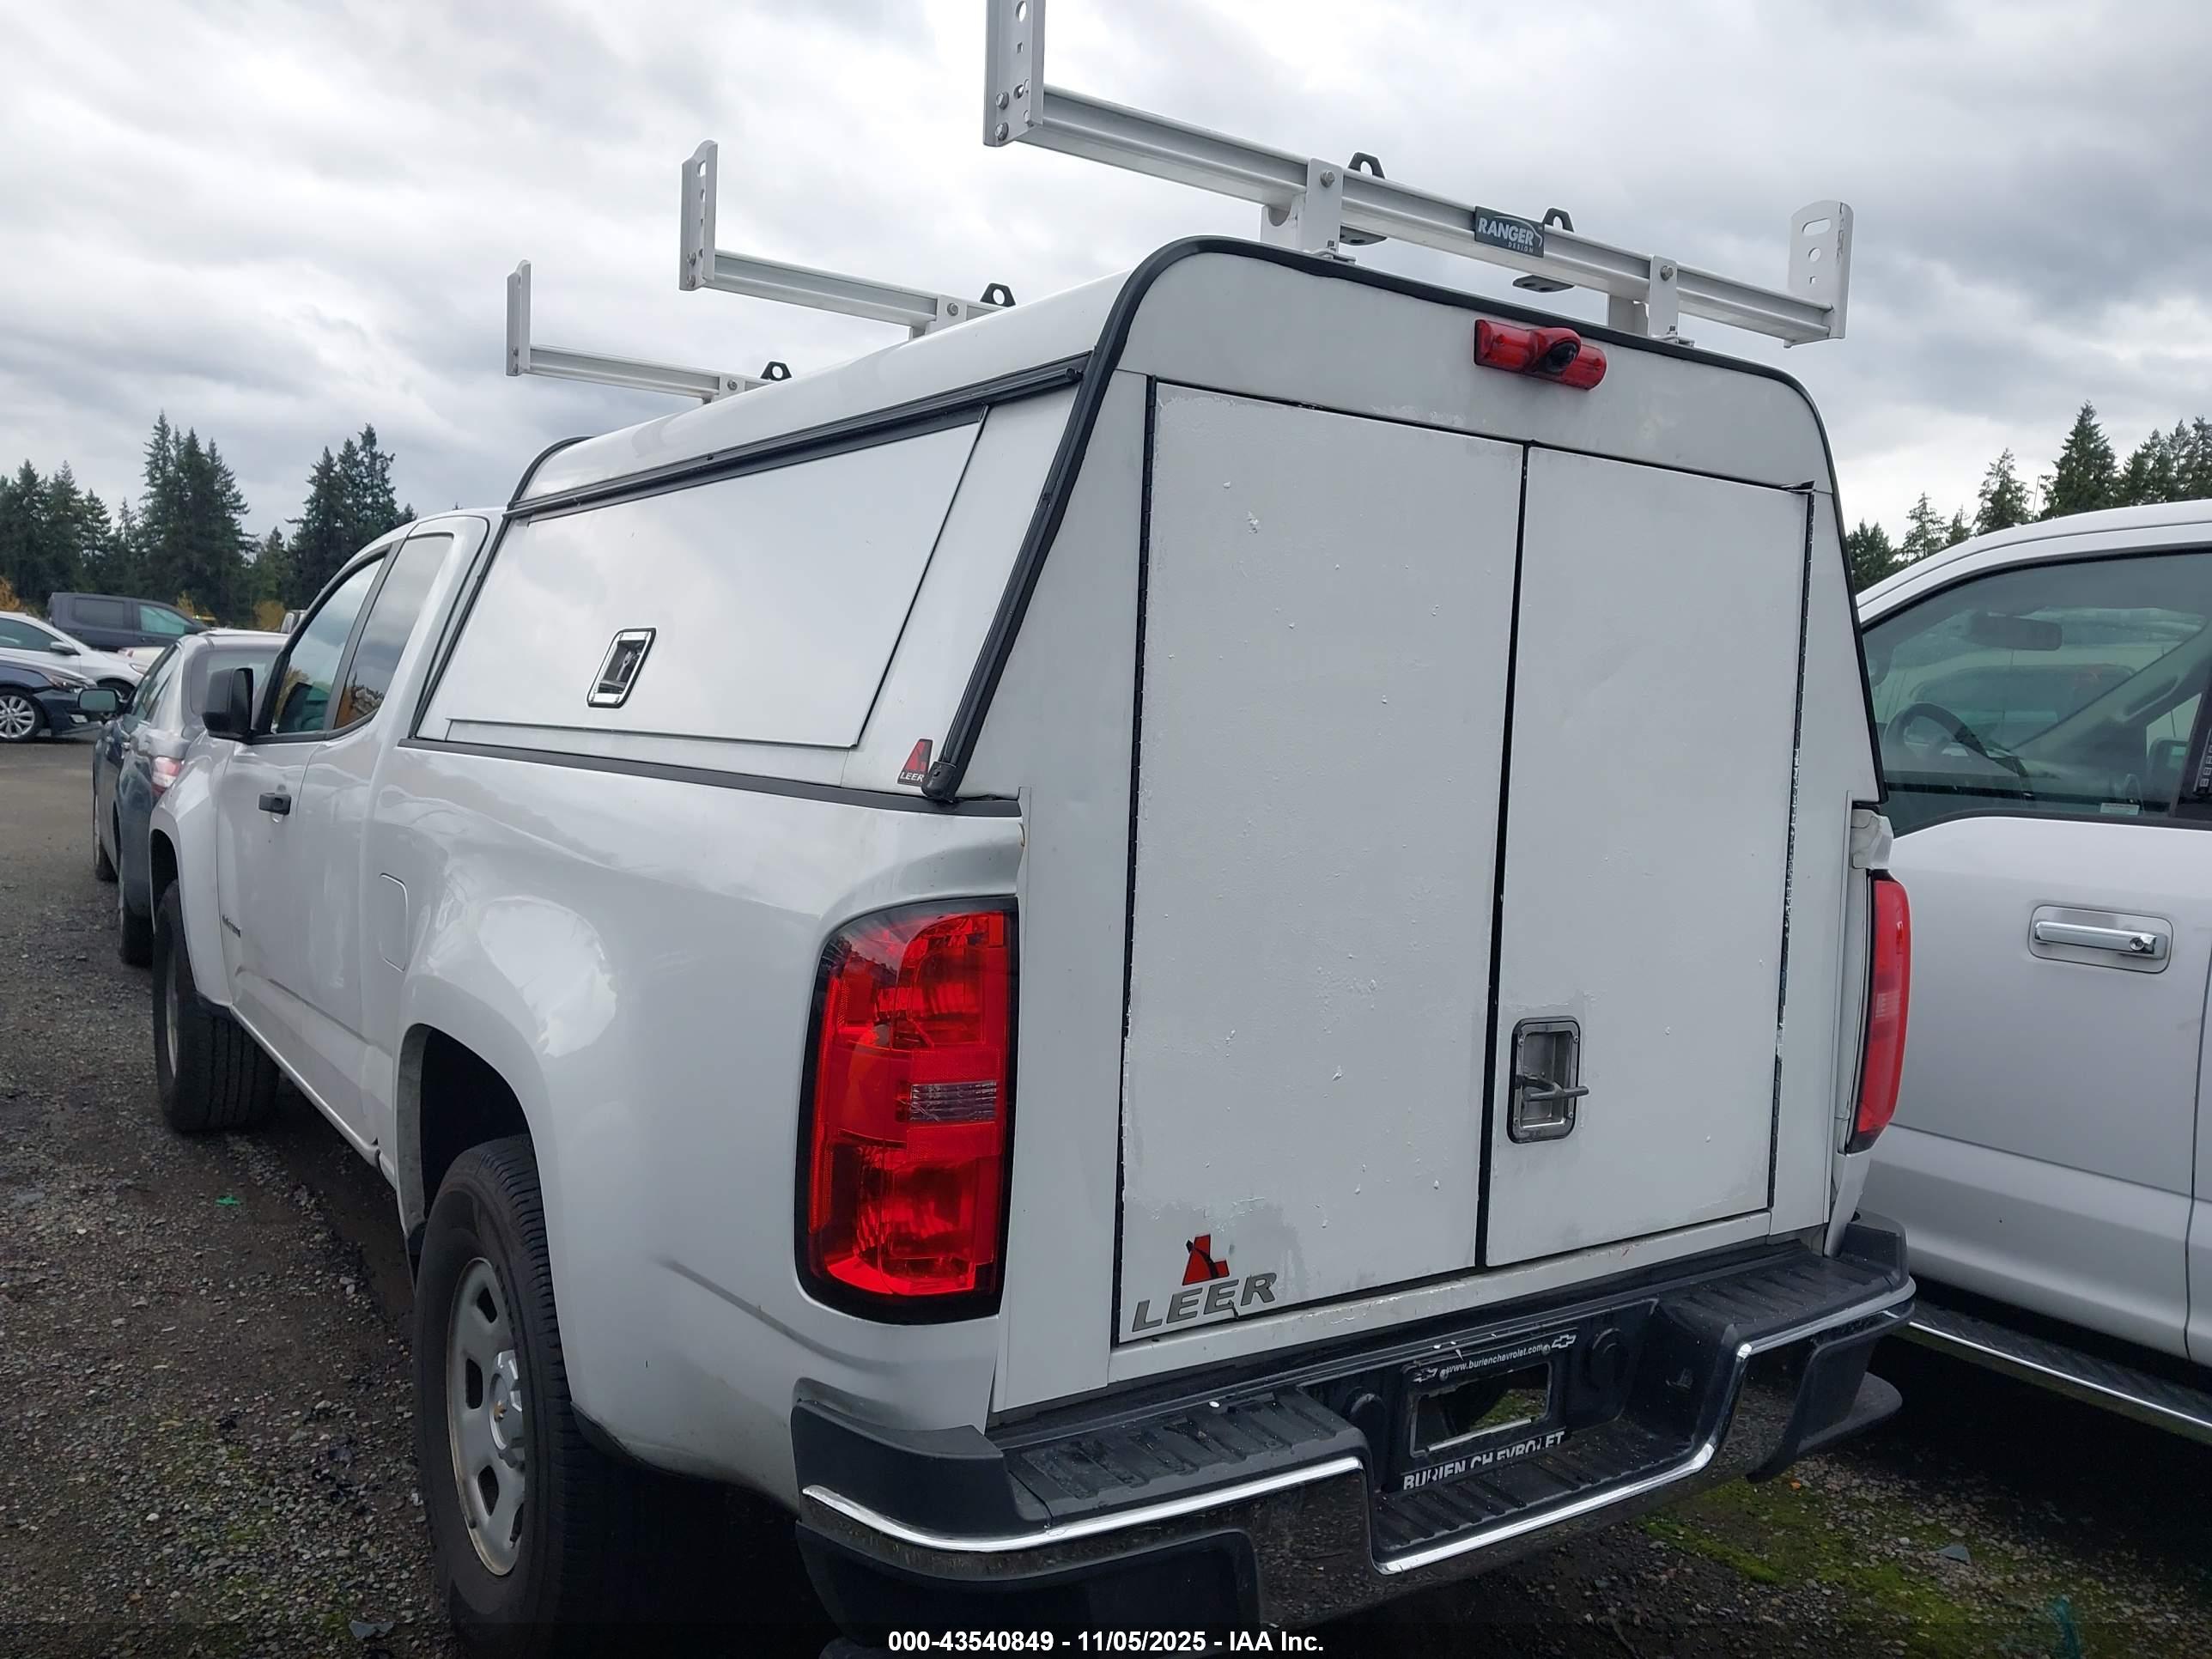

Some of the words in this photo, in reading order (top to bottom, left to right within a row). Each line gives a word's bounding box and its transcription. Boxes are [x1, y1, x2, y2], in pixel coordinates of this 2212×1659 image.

[1478, 217, 1534, 246] RANGER
[1508, 241, 1534, 253] DESIGN
[899, 771, 925, 782] LEER
[1132, 1272, 1278, 1333] LEER
[1446, 1345, 1543, 1373] www.burienchevrolet.com
